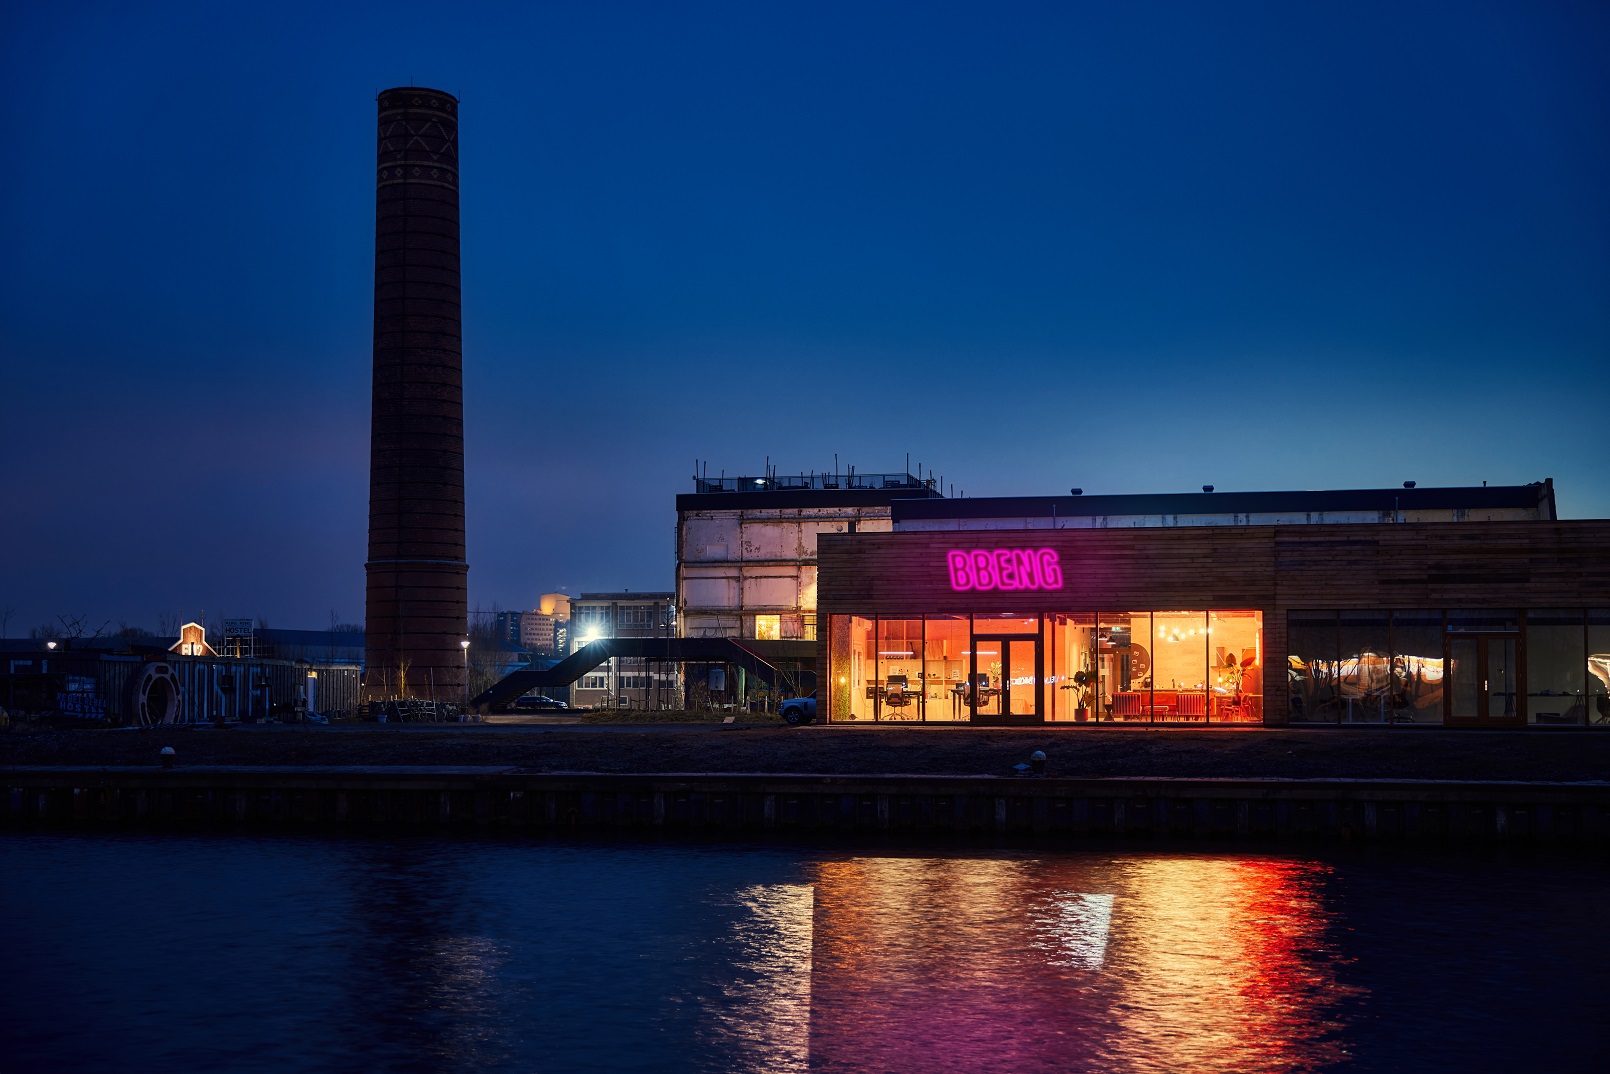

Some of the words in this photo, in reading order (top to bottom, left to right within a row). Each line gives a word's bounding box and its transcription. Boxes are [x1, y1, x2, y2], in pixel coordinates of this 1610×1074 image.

[948, 549, 1063, 590] BBENG
[57, 692, 83, 705] REBEL
[60, 701, 104, 713] HOSTEL
